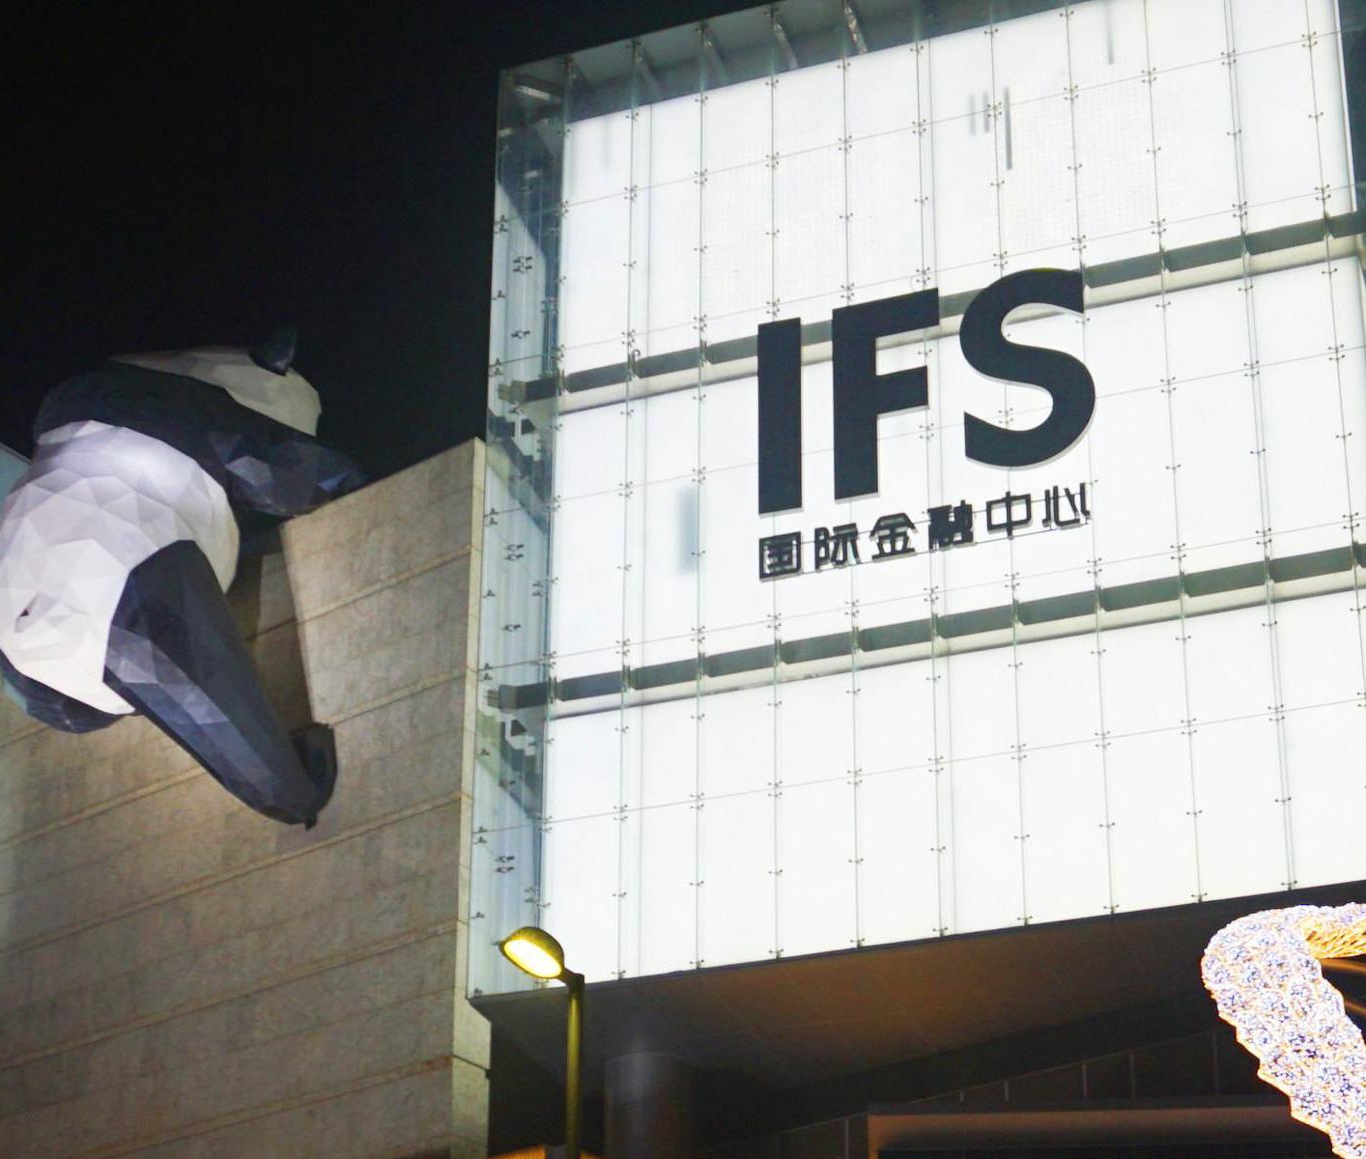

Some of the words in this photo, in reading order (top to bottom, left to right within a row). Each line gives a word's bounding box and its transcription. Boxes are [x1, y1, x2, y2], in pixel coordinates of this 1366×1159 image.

[757, 268, 1096, 516] IFS
[758, 481, 1092, 582] 国际金融中心
